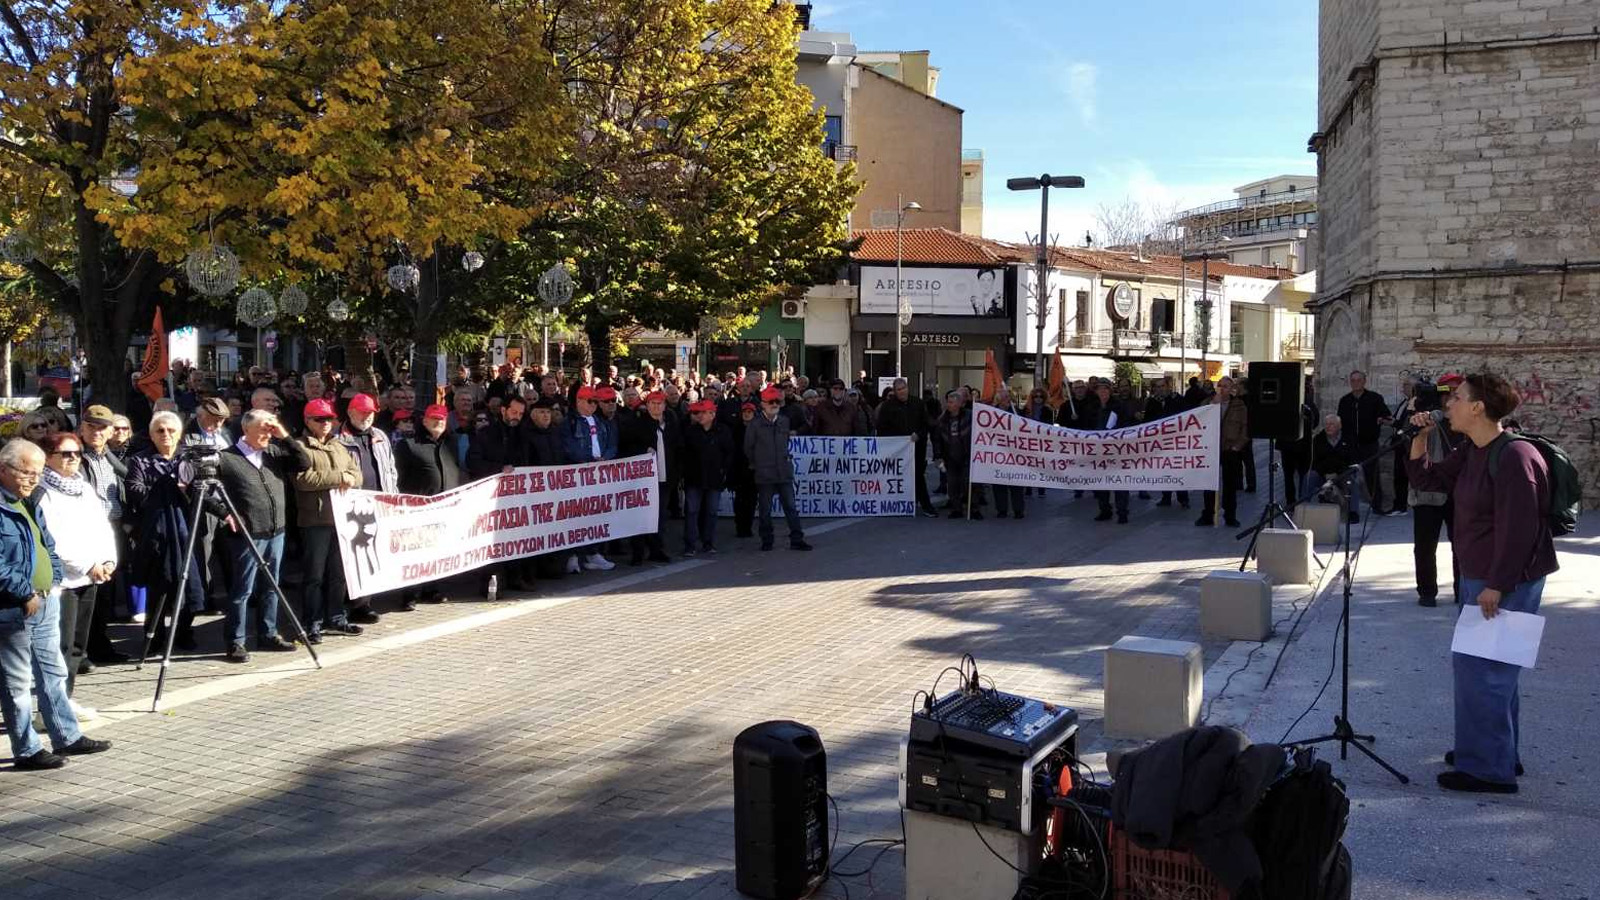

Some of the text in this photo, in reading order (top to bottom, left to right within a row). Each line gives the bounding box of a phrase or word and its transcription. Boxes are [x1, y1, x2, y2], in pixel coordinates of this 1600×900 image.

[875, 279, 942, 291] ARTESIO
[913, 334, 961, 343] ARTESIO
[976, 410, 1012, 431] ΟΧΙ
[843, 438, 859, 455] ΜΕ
[863, 438, 878, 455] ΤΑ
[975, 432, 1208, 456] ΑΥΞΗΣΕΙΣ ΣΤΙΣ ΣΥΝΤΑΞΕΙΣ.
[808, 459, 830, 475] ΔΕΝ
[835, 458, 904, 476] ΑΝΤΕΧΟΥΜΕ
[972, 451, 1046, 469] ΑΠΟΔΟΣΗ
[1121, 455, 1210, 470] ΣΥΝΤΑΞΗΣ.
[530, 473, 546, 493] ΣΕ
[547, 469, 577, 491] ΟΛΕΣ
[578, 466, 597, 487] ΤΙΣ
[598, 459, 655, 484] ΣΥΝΤΑΞΕΙΣ
[994, 469, 1037, 481] Σωματείο
[1039, 472, 1102, 487] Συνταξιούχων
[1105, 475, 1123, 484] ΙΚΑ
[850, 479, 882, 495] ΤΩΡΑ
[886, 479, 904, 494] ΣΕ
[531, 501, 554, 525] ΤΗΣ
[555, 494, 613, 521] ΔΗΜΟΣΙΑΣ
[615, 488, 650, 511] ΥΓΕΙΑΣ
[880, 501, 914, 514] ΝΑΟΥΣΑΣ
[402, 554, 461, 580] ΣΩΜΑΤΕΙΟ
[463, 536, 545, 568] ΣΥΝΤΑΞΙΟΥΧΩΝ
[548, 533, 566, 548] ΙΚΑ
[568, 523, 610, 544] ΒΕΡΟΙΑΣ
